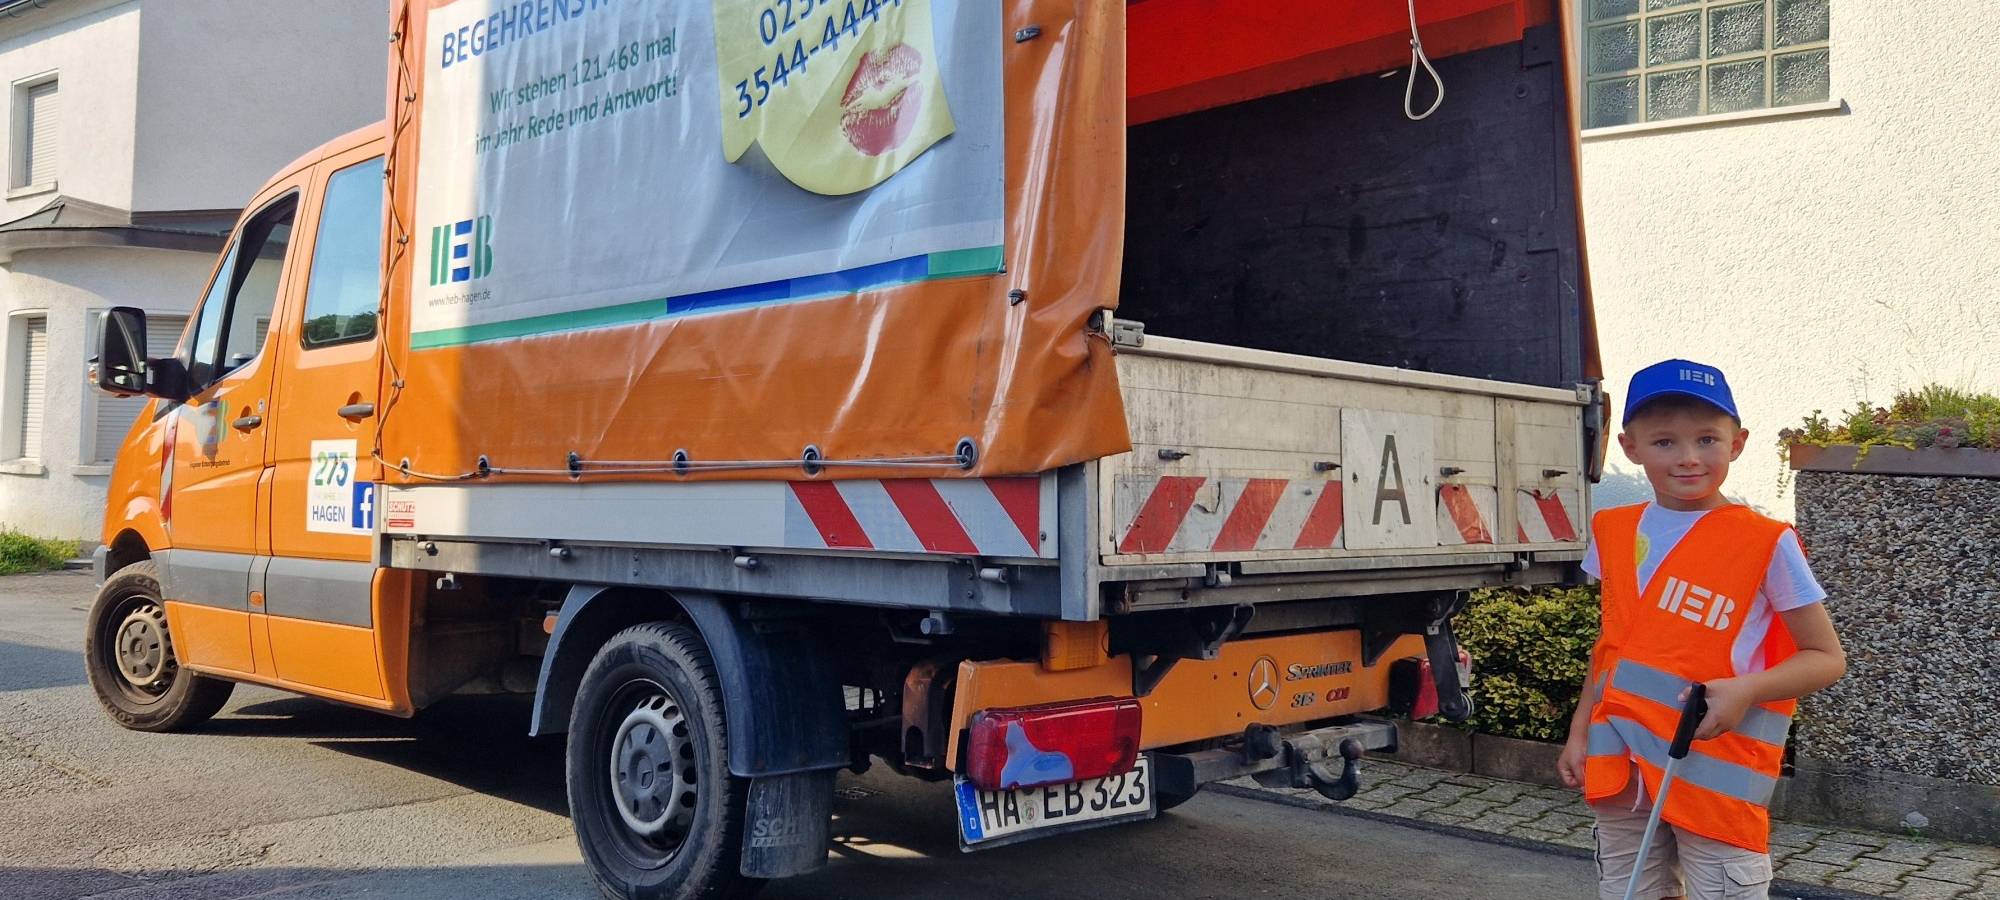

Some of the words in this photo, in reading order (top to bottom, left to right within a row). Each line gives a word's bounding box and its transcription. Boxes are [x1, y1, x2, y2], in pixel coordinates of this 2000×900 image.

[441, 0, 609, 69] BEGEHRENS
[490, 88, 514, 114] Wir
[517, 72, 567, 105] stehen
[572, 41, 640, 87] 121.468
[646, 27, 677, 63] mal
[735, 0, 901, 118] 3544-444
[476, 132, 493, 155] im
[494, 122, 525, 150] Jahr
[528, 108, 565, 139] Rede
[569, 96, 599, 126] und
[602, 67, 678, 118] Antwort!
[315, 451, 349, 487] 275
[1372, 434, 1411, 525] A
[312, 505, 346, 522] HAGEN
[979, 789, 1021, 831] HA
[1043, 779, 1085, 819] EB
[1090, 766, 1146, 812] 323
